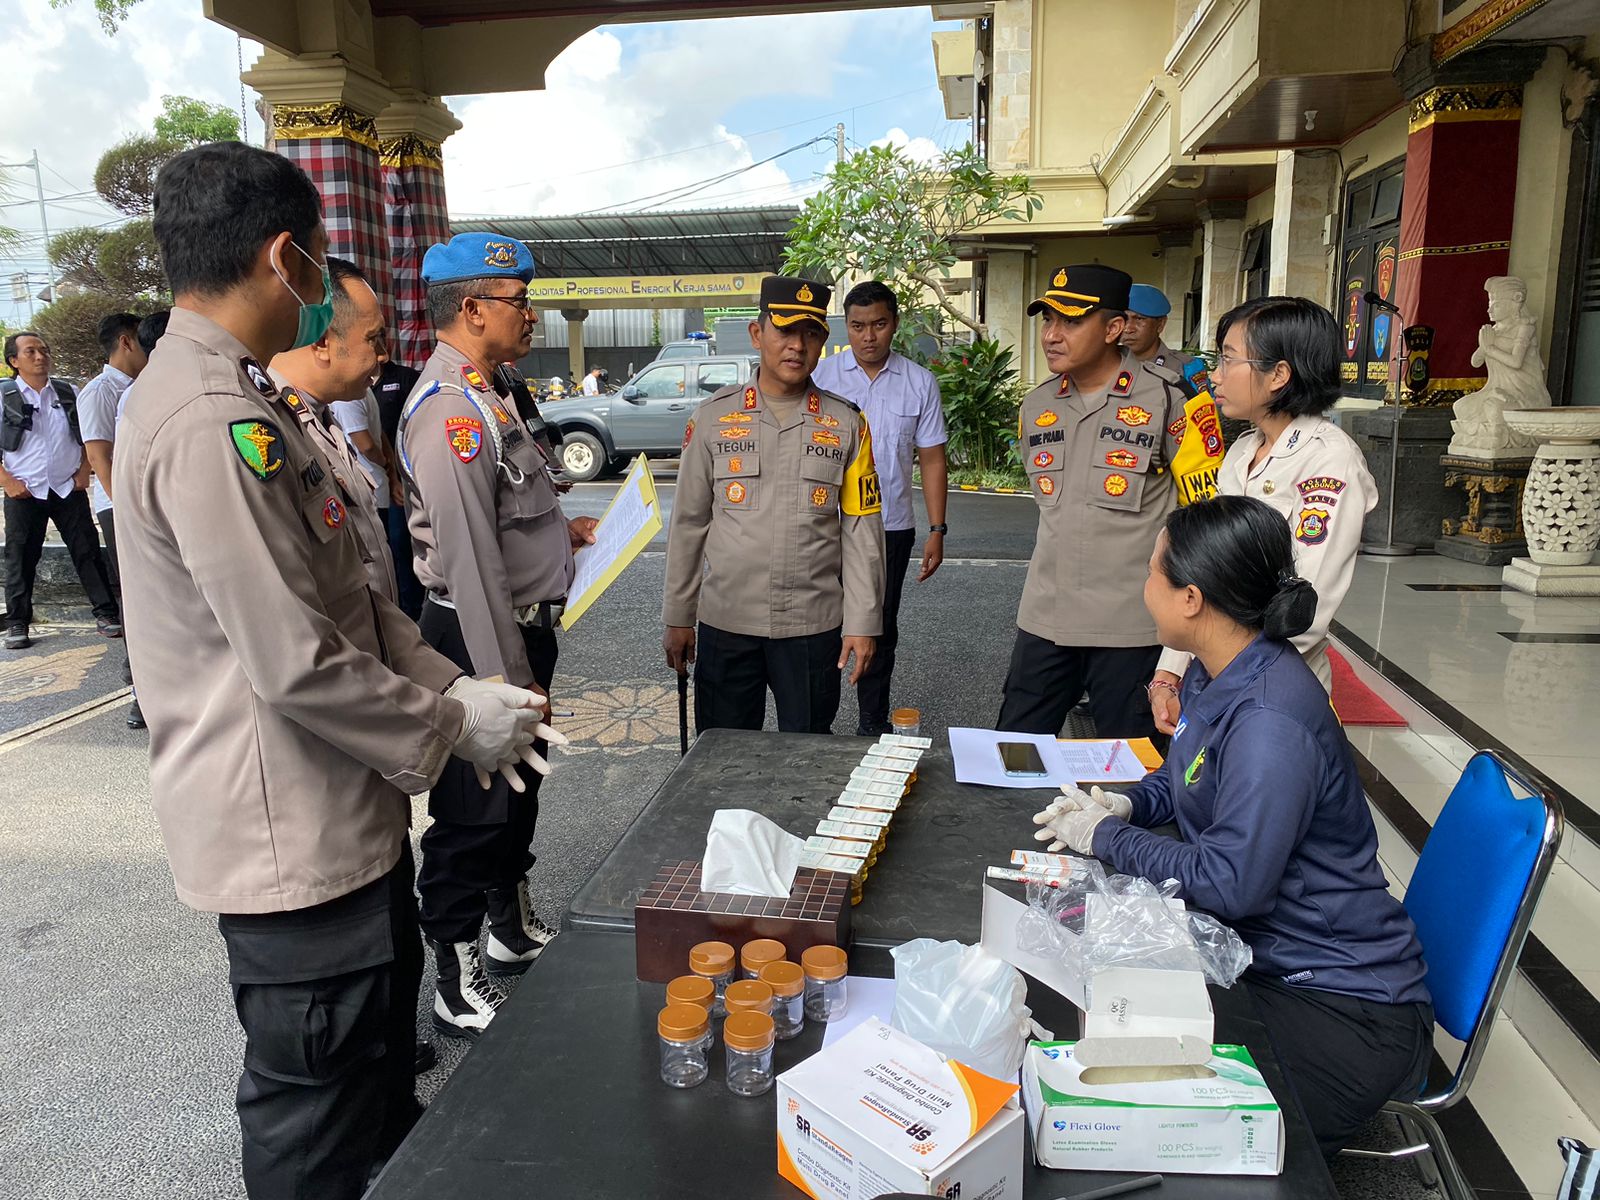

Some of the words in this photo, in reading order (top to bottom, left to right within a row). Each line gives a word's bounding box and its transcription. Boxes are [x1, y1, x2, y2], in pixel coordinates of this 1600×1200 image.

[566, 281, 630, 295] PROFESIONAL
[631, 280, 671, 293] ENERGIK
[673, 279, 705, 293] KERJA
[707, 284, 732, 292] SAMA
[447, 417, 479, 427] PROPAM
[1100, 426, 1155, 448] POLRI
[716, 442, 756, 453] TEGUH
[806, 445, 843, 461] POLRI
[1301, 477, 1342, 488] POLRES
[1304, 482, 1337, 491] BADUNG
[1307, 495, 1332, 504] BALI
[1110, 1002, 1119, 1013] QC
[863, 1068, 877, 1078] Kit
[875, 1063, 903, 1082] Panel
[876, 1075, 915, 1101] Diagnostic
[903, 1079, 927, 1096] Drug
[1209, 1087, 1229, 1095] PCS
[914, 1096, 943, 1116] Combo
[926, 1092, 952, 1109] Multi
[863, 1094, 912, 1127] StandaReagen
[796, 1114, 811, 1136] SR
[905, 1123, 932, 1142] SR
[1070, 1122, 1092, 1131] Flexi
[1094, 1122, 1121, 1131] Glove
[1158, 1143, 1174, 1152] 100
[1175, 1143, 1194, 1152] PCS
[797, 1147, 815, 1165] Combo
[815, 1160, 842, 1184] Diagnostic
[843, 1181, 851, 1191] Kit
[797, 1157, 813, 1172] Multi
[813, 1170, 829, 1186] Drug
[830, 1182, 849, 1199] Panel
[945, 1181, 961, 1200] SR
